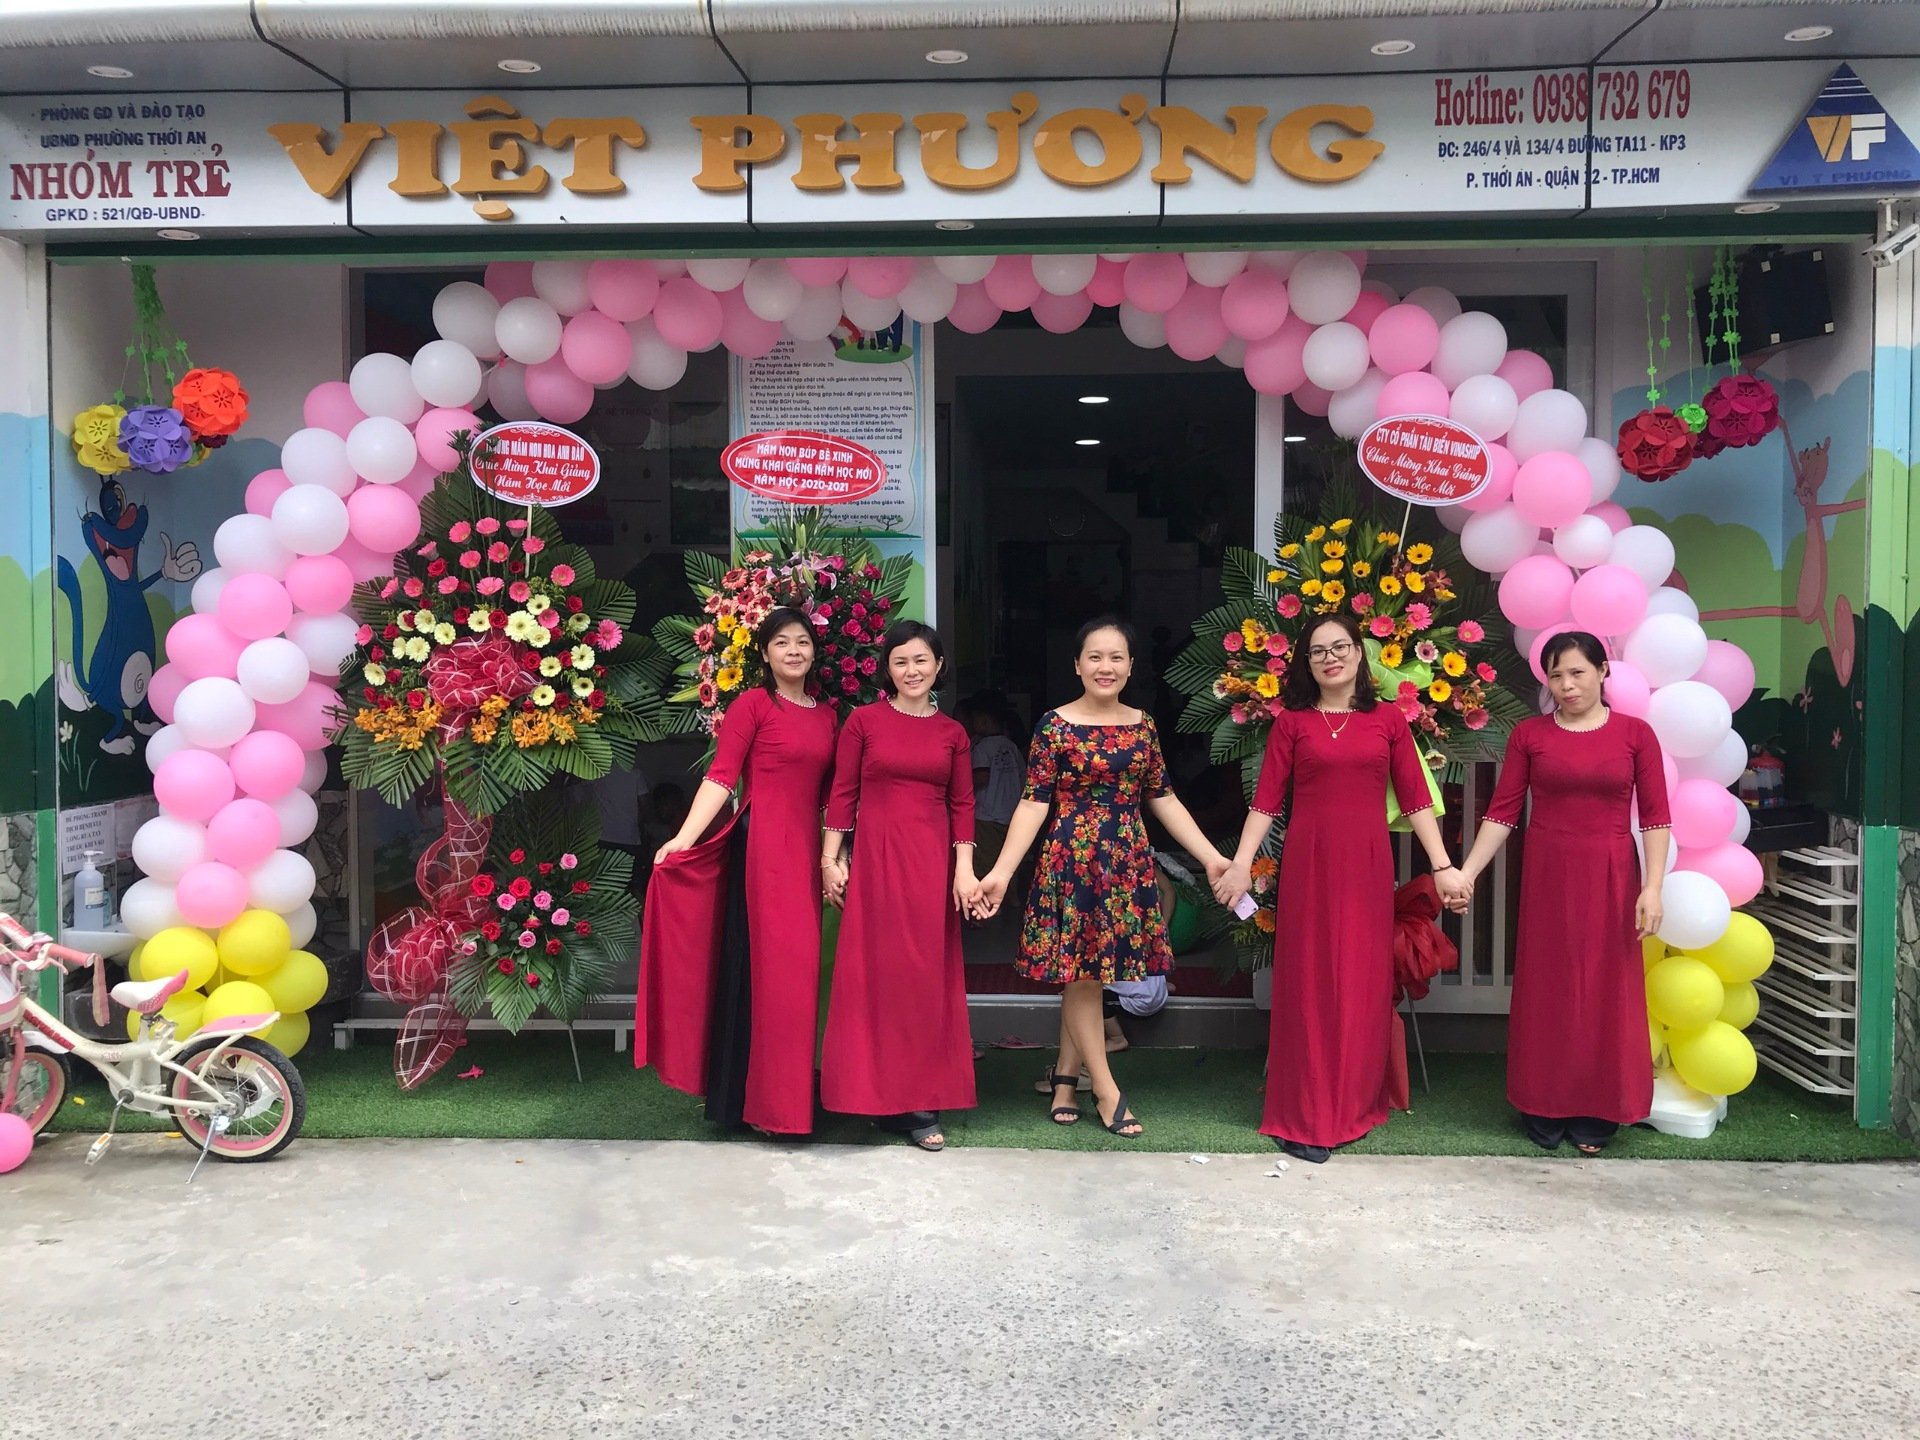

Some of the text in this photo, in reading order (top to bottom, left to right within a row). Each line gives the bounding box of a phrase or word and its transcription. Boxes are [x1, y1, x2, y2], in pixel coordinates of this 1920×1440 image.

[1435, 68, 1690, 126] Hotline: 0938 732 679
[40, 102, 206, 120] PHÒNG GD VÀ ĐÀO TẠO
[40, 128, 206, 148] UBND PHƯỜNG THỚI AN
[1438, 142, 1459, 158] ĐC:
[1463, 140, 1501, 156] 246/4
[1505, 136, 1521, 156] VÀ
[1526, 138, 1564, 155] 134/4
[1615, 136, 1646, 152] TA11
[1660, 134, 1686, 150] KP3
[266, 91, 1385, 220] VIỆT PHƯƠNG
[10, 144, 232, 200] NHÓM TRẺ
[1466, 172, 1478, 188] P.
[1482, 164, 1512, 187] THỚI
[1516, 171, 1532, 186] AN
[1545, 166, 1579, 189] QUẬN
[1584, 168, 1600, 184] 12
[1611, 168, 1660, 184] TP.HCM
[46, 208, 88, 221] GPKD
[1376, 424, 1481, 460] CTY CỔ PHẦN TÀU BIỂN VINASHIP
[780, 446, 796, 458] NON
[799, 446, 816, 460] BÚP
[820, 448, 830, 461] BÊ
[832, 452, 852, 463] XINH
[500, 458, 529, 476] Mừng
[531, 460, 558, 476] Khai
[560, 462, 590, 480] Giảng
[736, 456, 872, 480] MỪNG KHAI GIẢNG NĂM HỌC MỚI
[1366, 446, 1482, 488] Chúc Mừng Khai Giảng
[494, 474, 572, 493] Năm Học Mới
[754, 474, 848, 492] NĂM HỌC 2020-2021
